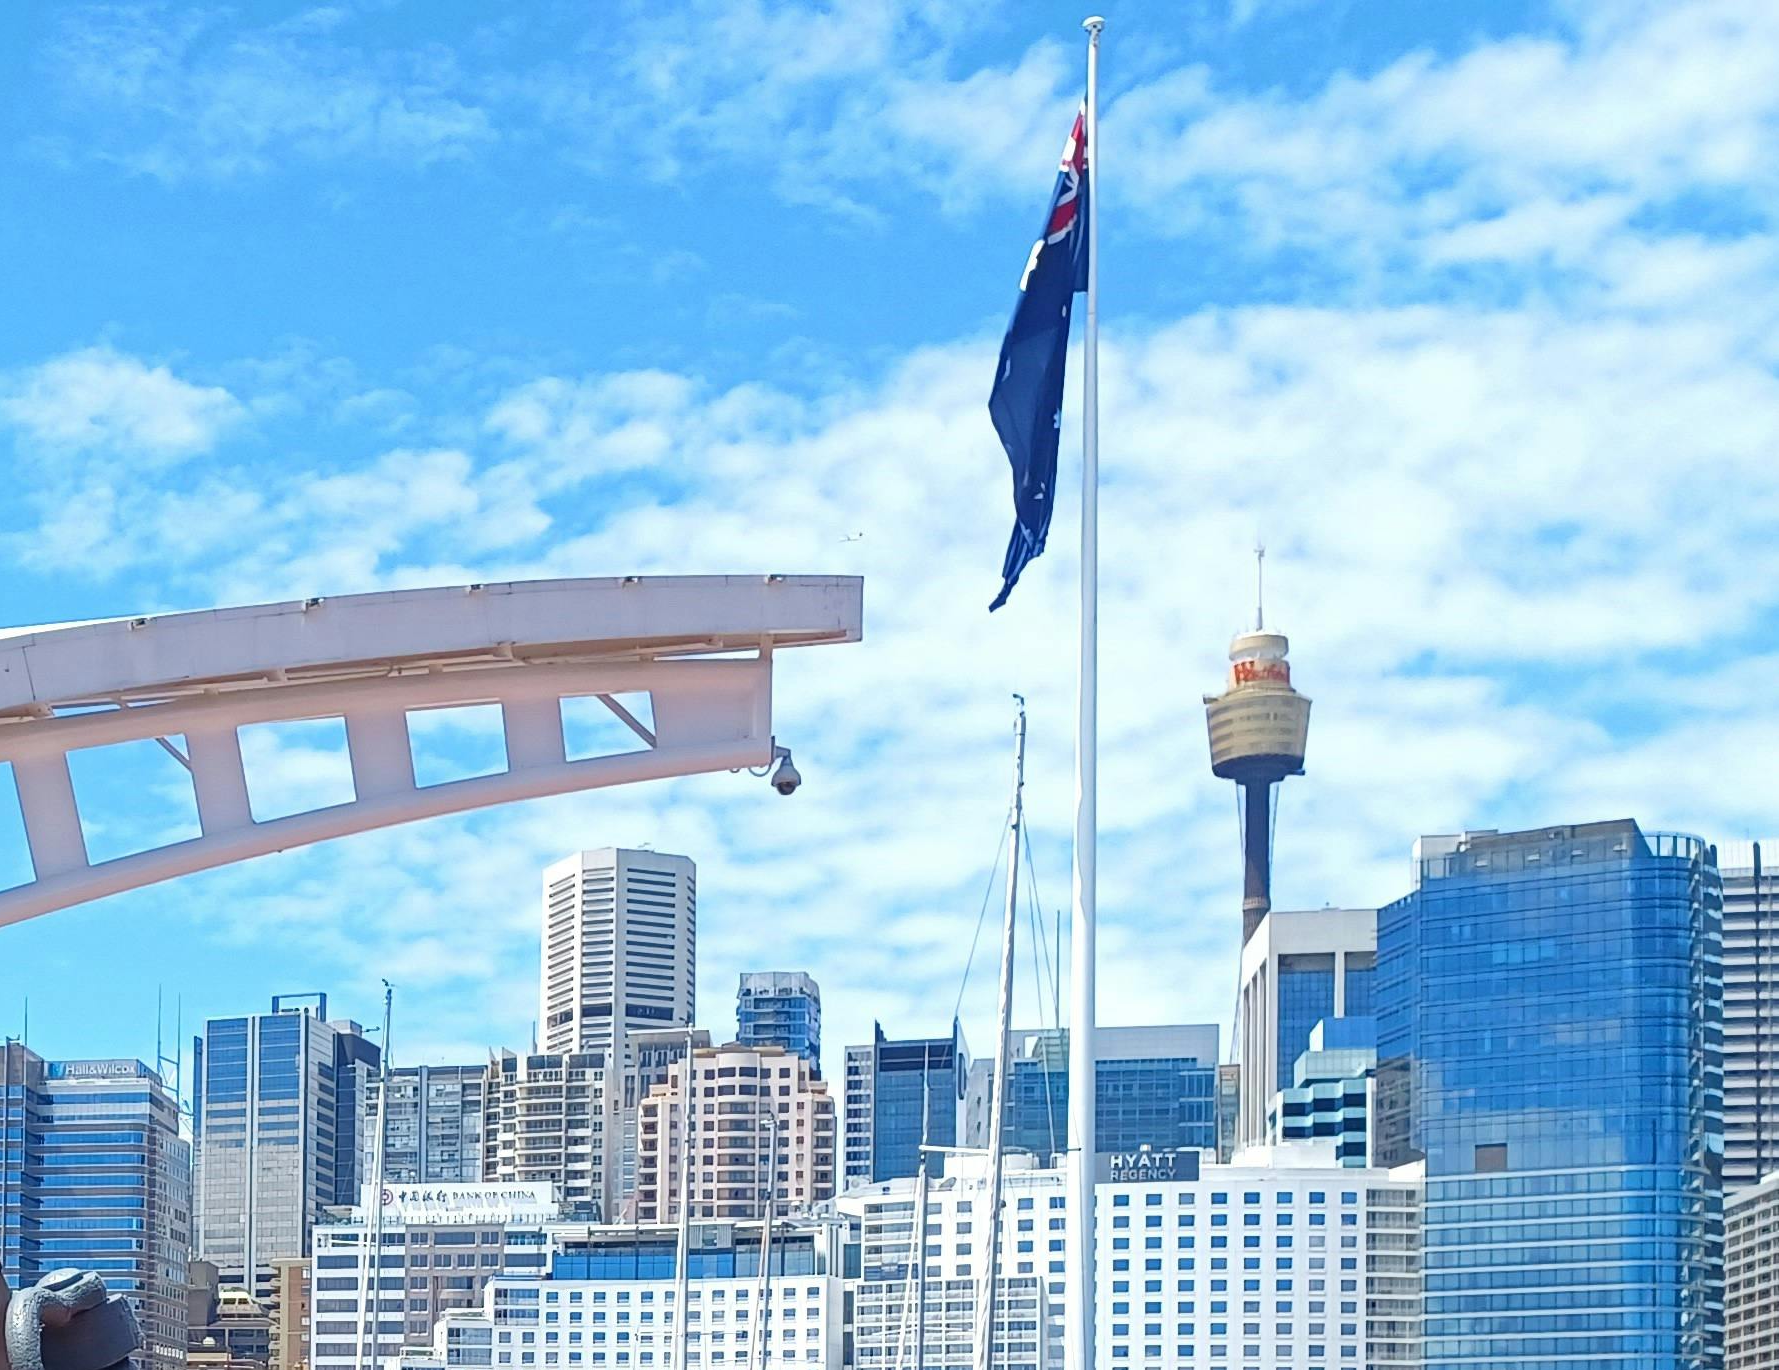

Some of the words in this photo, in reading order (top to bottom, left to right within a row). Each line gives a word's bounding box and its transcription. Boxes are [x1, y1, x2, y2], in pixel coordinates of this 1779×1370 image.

[65, 1063, 135, 1076] Hall&Wilcox
[1110, 1153, 1176, 1169] HYATT
[1110, 1169, 1176, 1181] REGENCY
[452, 1191, 482, 1200] BANK
[485, 1191, 499, 1200] OF
[500, 1190, 536, 1200] CHINA
